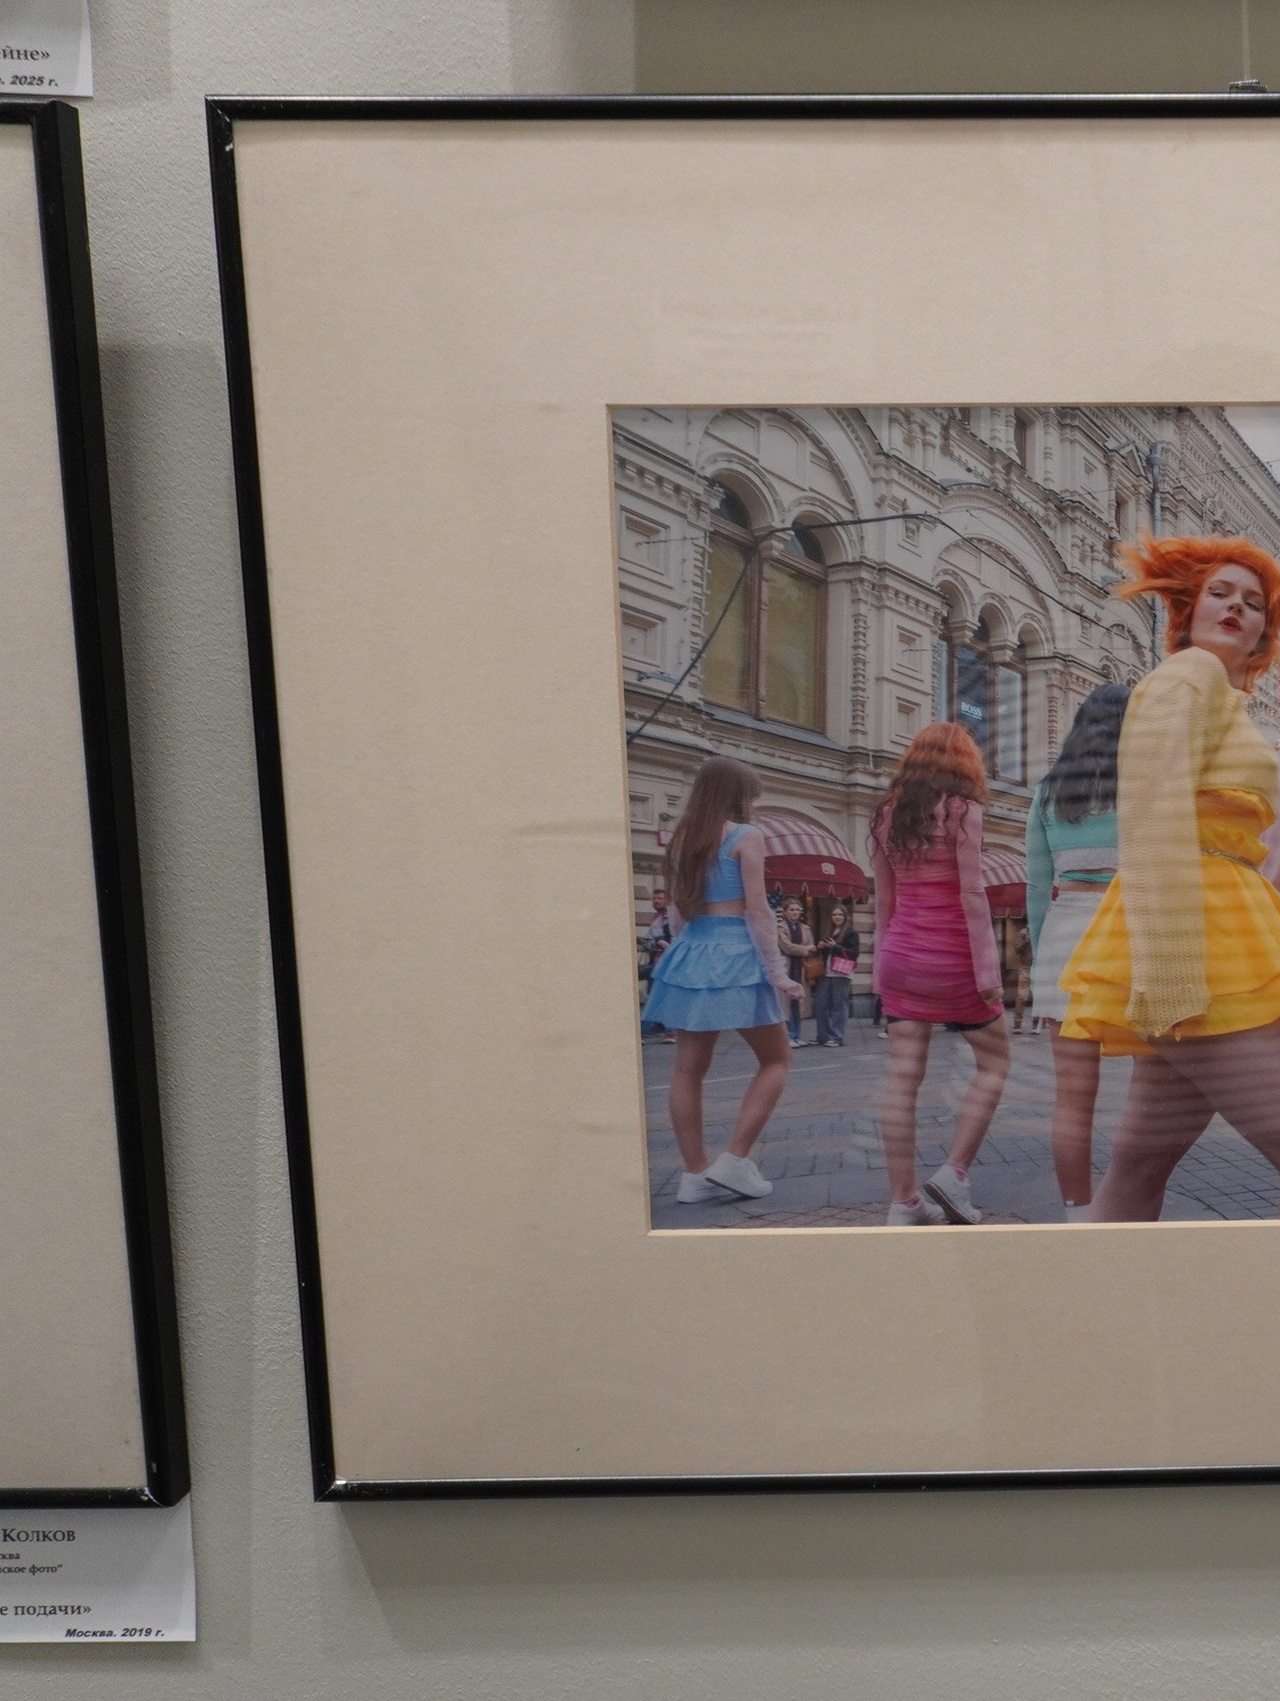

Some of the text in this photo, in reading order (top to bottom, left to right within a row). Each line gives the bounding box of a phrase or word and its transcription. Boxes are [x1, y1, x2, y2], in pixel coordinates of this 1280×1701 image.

[10, 74, 45, 86] 2025
[48, 78, 58, 87] г.
[0, 1566, 26, 1574] ское
[14, 1605, 92, 1617] подачи»
[65, 1627, 165, 1638] Москва. 2019 г.
